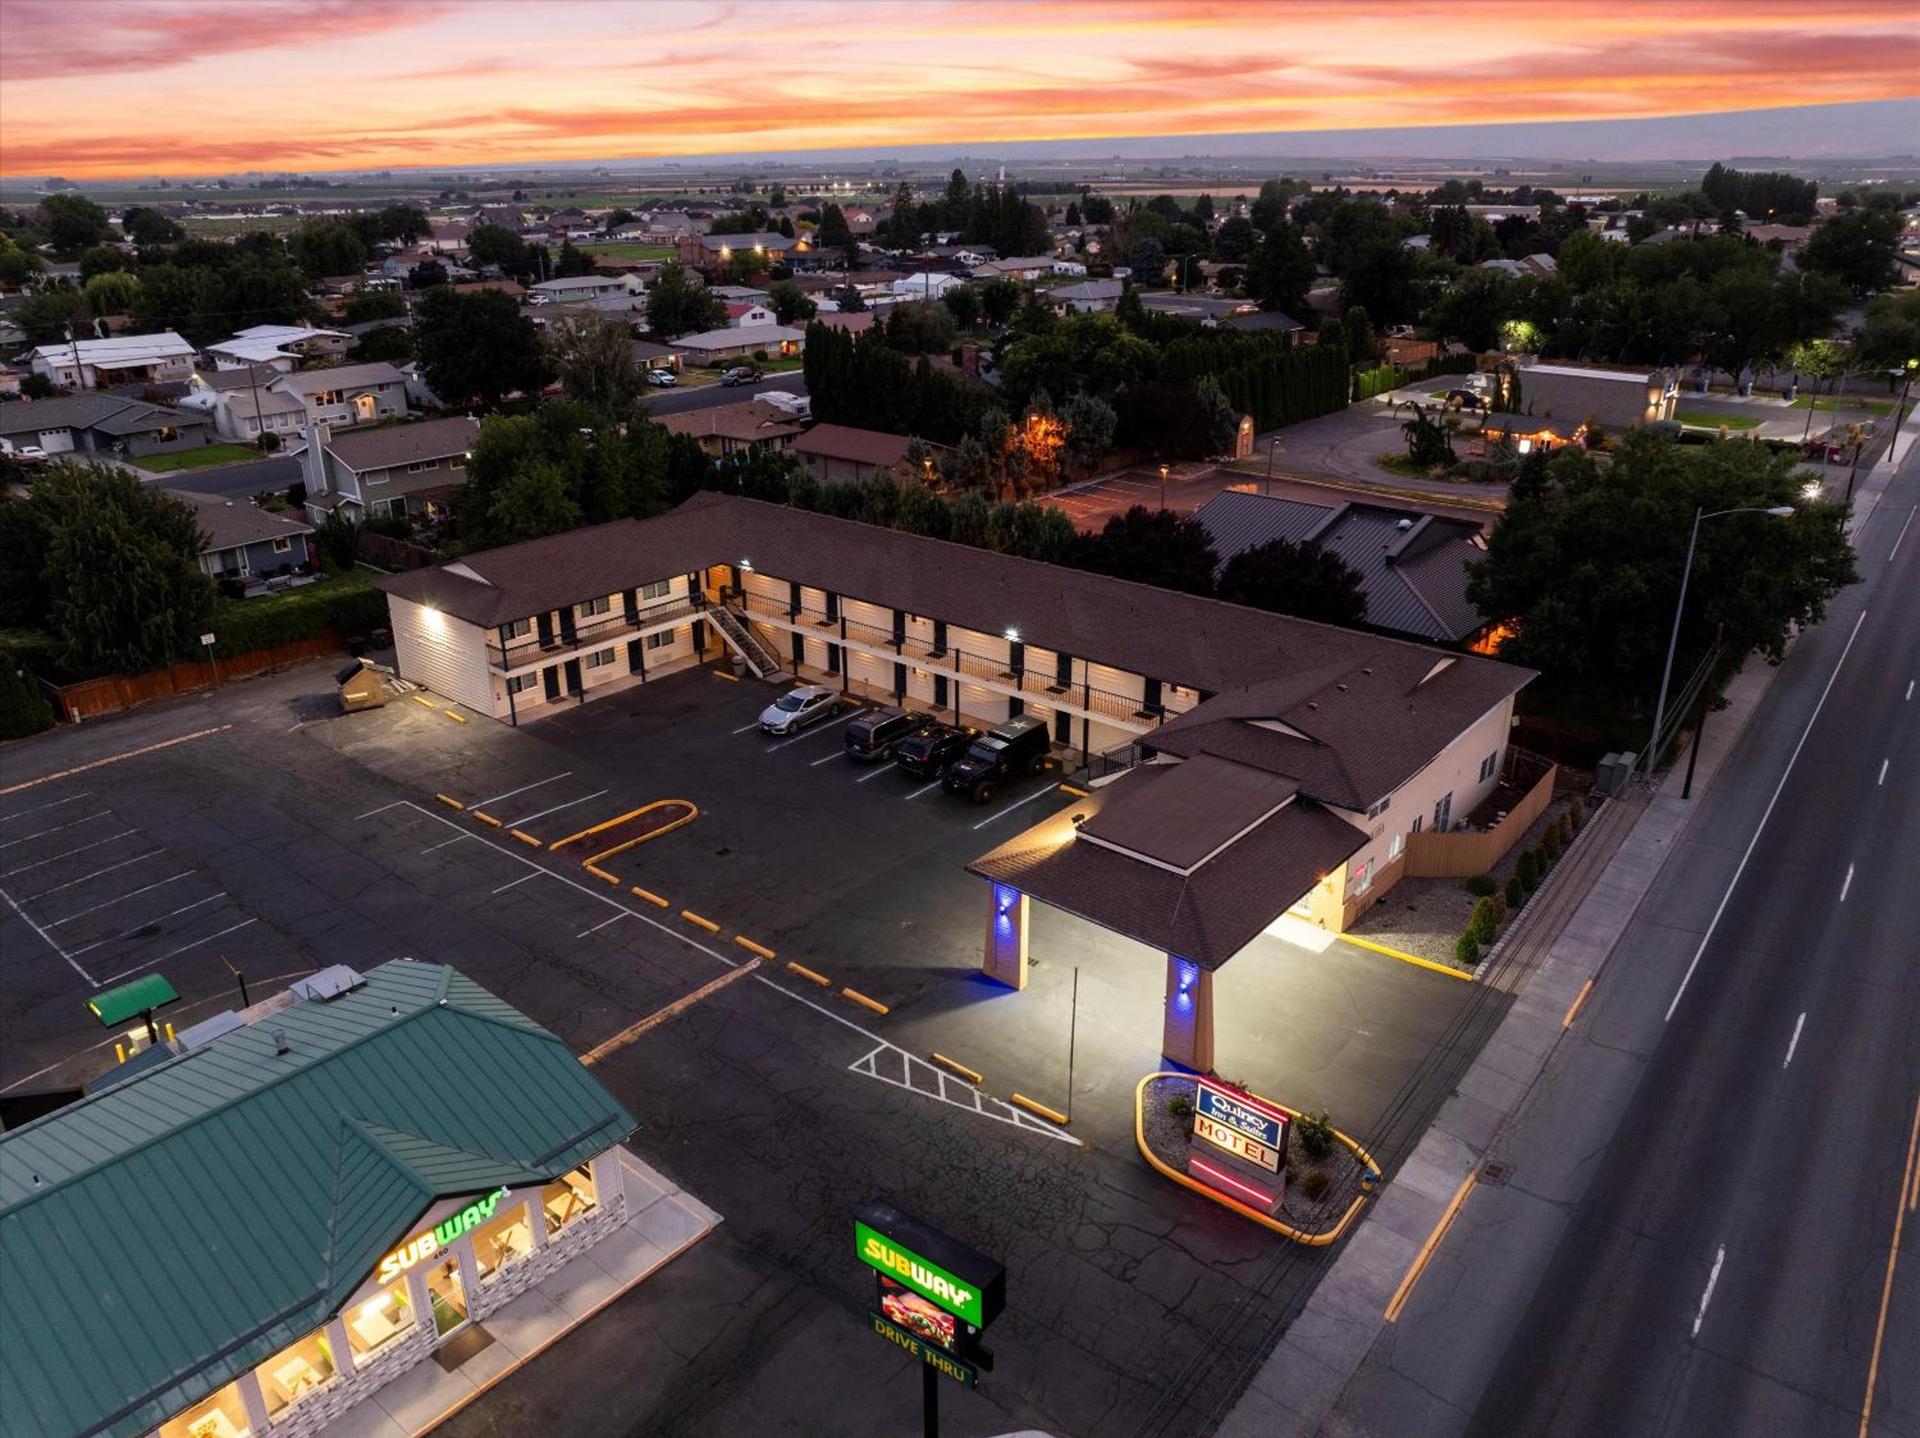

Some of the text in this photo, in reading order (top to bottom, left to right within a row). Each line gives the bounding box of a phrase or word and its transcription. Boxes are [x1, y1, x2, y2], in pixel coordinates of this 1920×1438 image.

[1200, 1120, 1274, 1167] MOTEL
[1211, 1095, 1268, 1130] Quincy
[377, 1186, 511, 1284] SUBWAY
[864, 1238, 973, 1308] SUBWAY
[875, 1319, 965, 1381] DRIVE THRU
